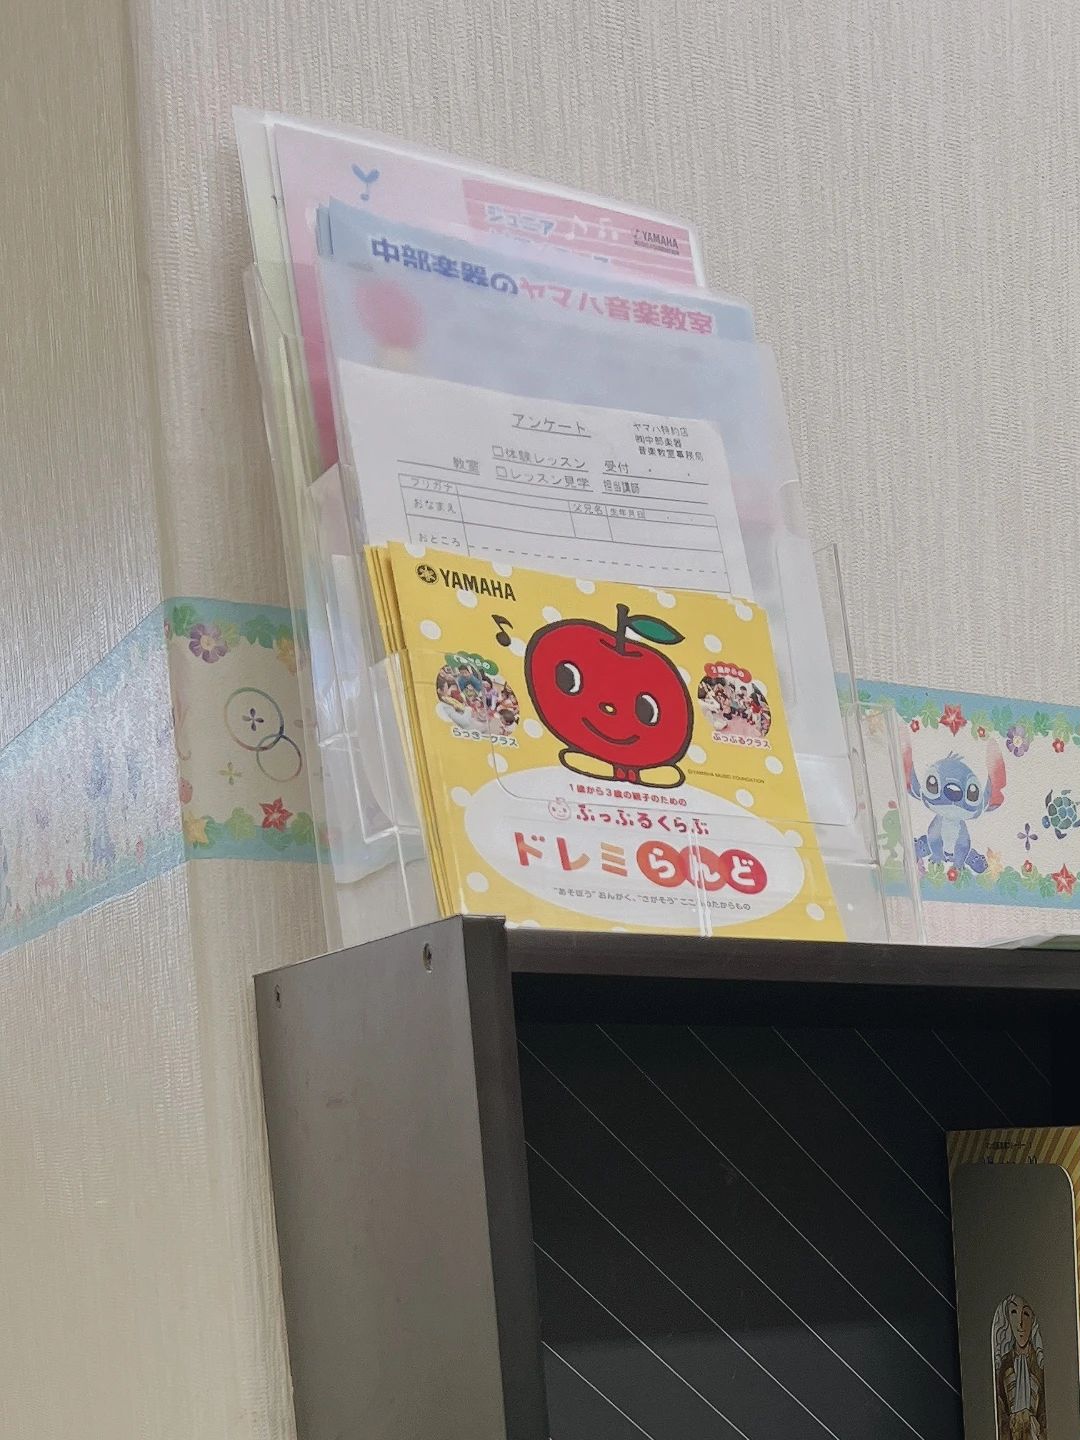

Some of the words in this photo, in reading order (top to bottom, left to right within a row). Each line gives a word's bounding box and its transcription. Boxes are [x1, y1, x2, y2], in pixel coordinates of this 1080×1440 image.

[642, 230, 679, 249] YAMAHA
[512, 413, 586, 434] アンケート
[452, 456, 480, 473] 教室
[604, 460, 630, 475] 受付
[603, 479, 641, 495] 担当講師
[413, 497, 457, 514] おなまえ
[418, 532, 461, 547] おところ
[439, 567, 517, 602] YAMAHA
[568, 783, 687, 807] 1歳から3歳の親子のための
[576, 804, 710, 836] ぷっぷるくらぶ
